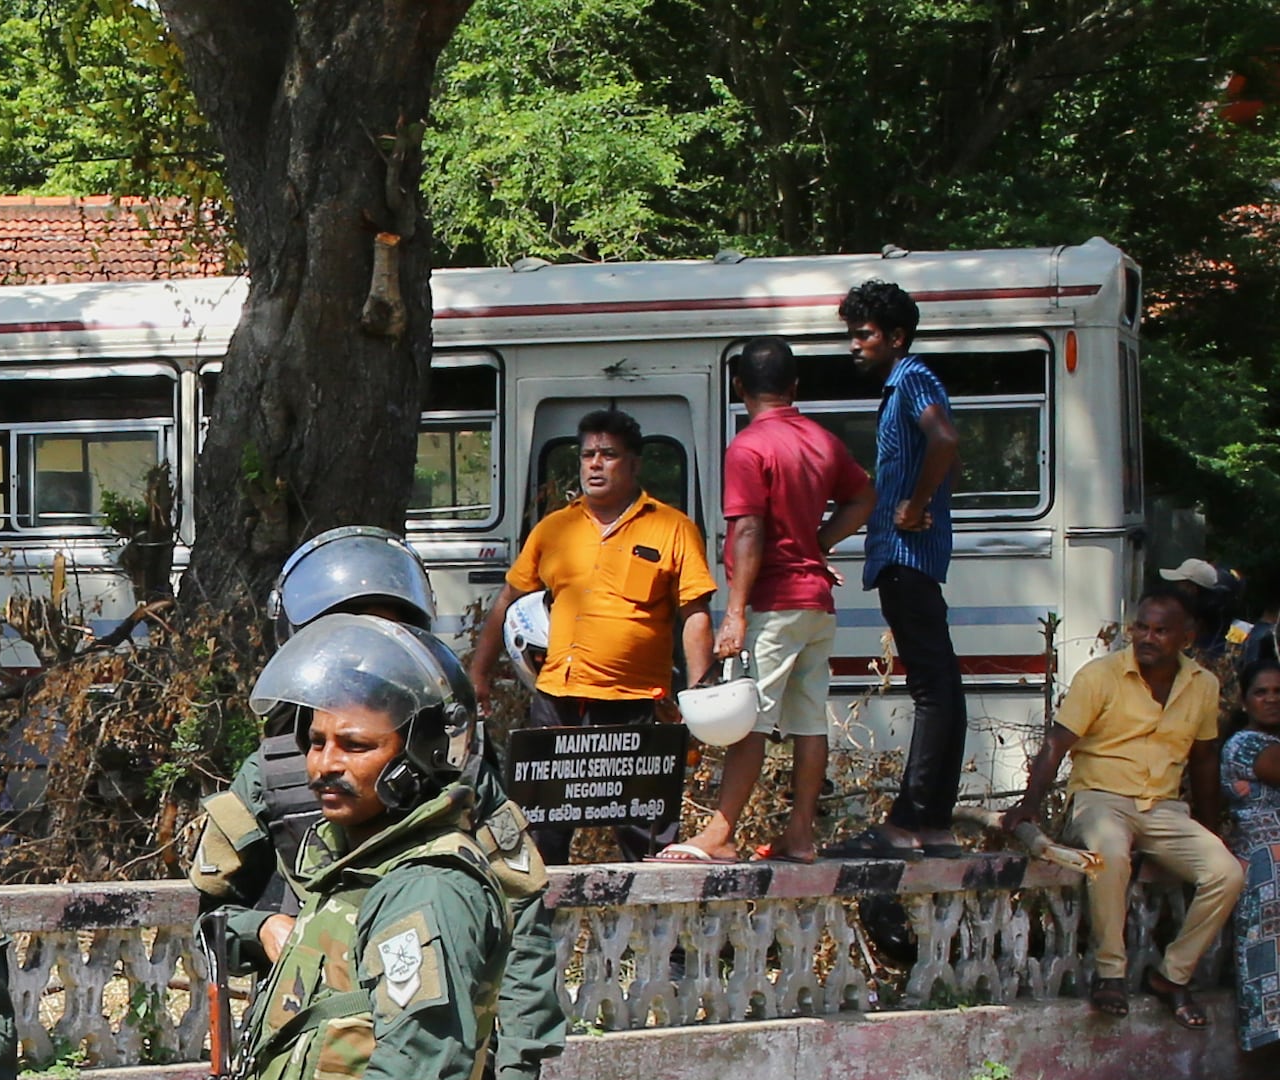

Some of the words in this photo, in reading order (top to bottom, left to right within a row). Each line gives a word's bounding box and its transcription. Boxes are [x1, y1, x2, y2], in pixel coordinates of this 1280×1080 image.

[479, 547, 497, 558] IN
[555, 732, 641, 754] MAINTAINED
[515, 762, 529, 782] BY
[531, 760, 551, 780] THE
[551, 758, 586, 780] PUBLIC
[587, 756, 634, 778] SERVICES
[636, 756, 661, 776] CLUB
[663, 755, 676, 774] OF
[565, 781, 623, 799] NEGOMBO
